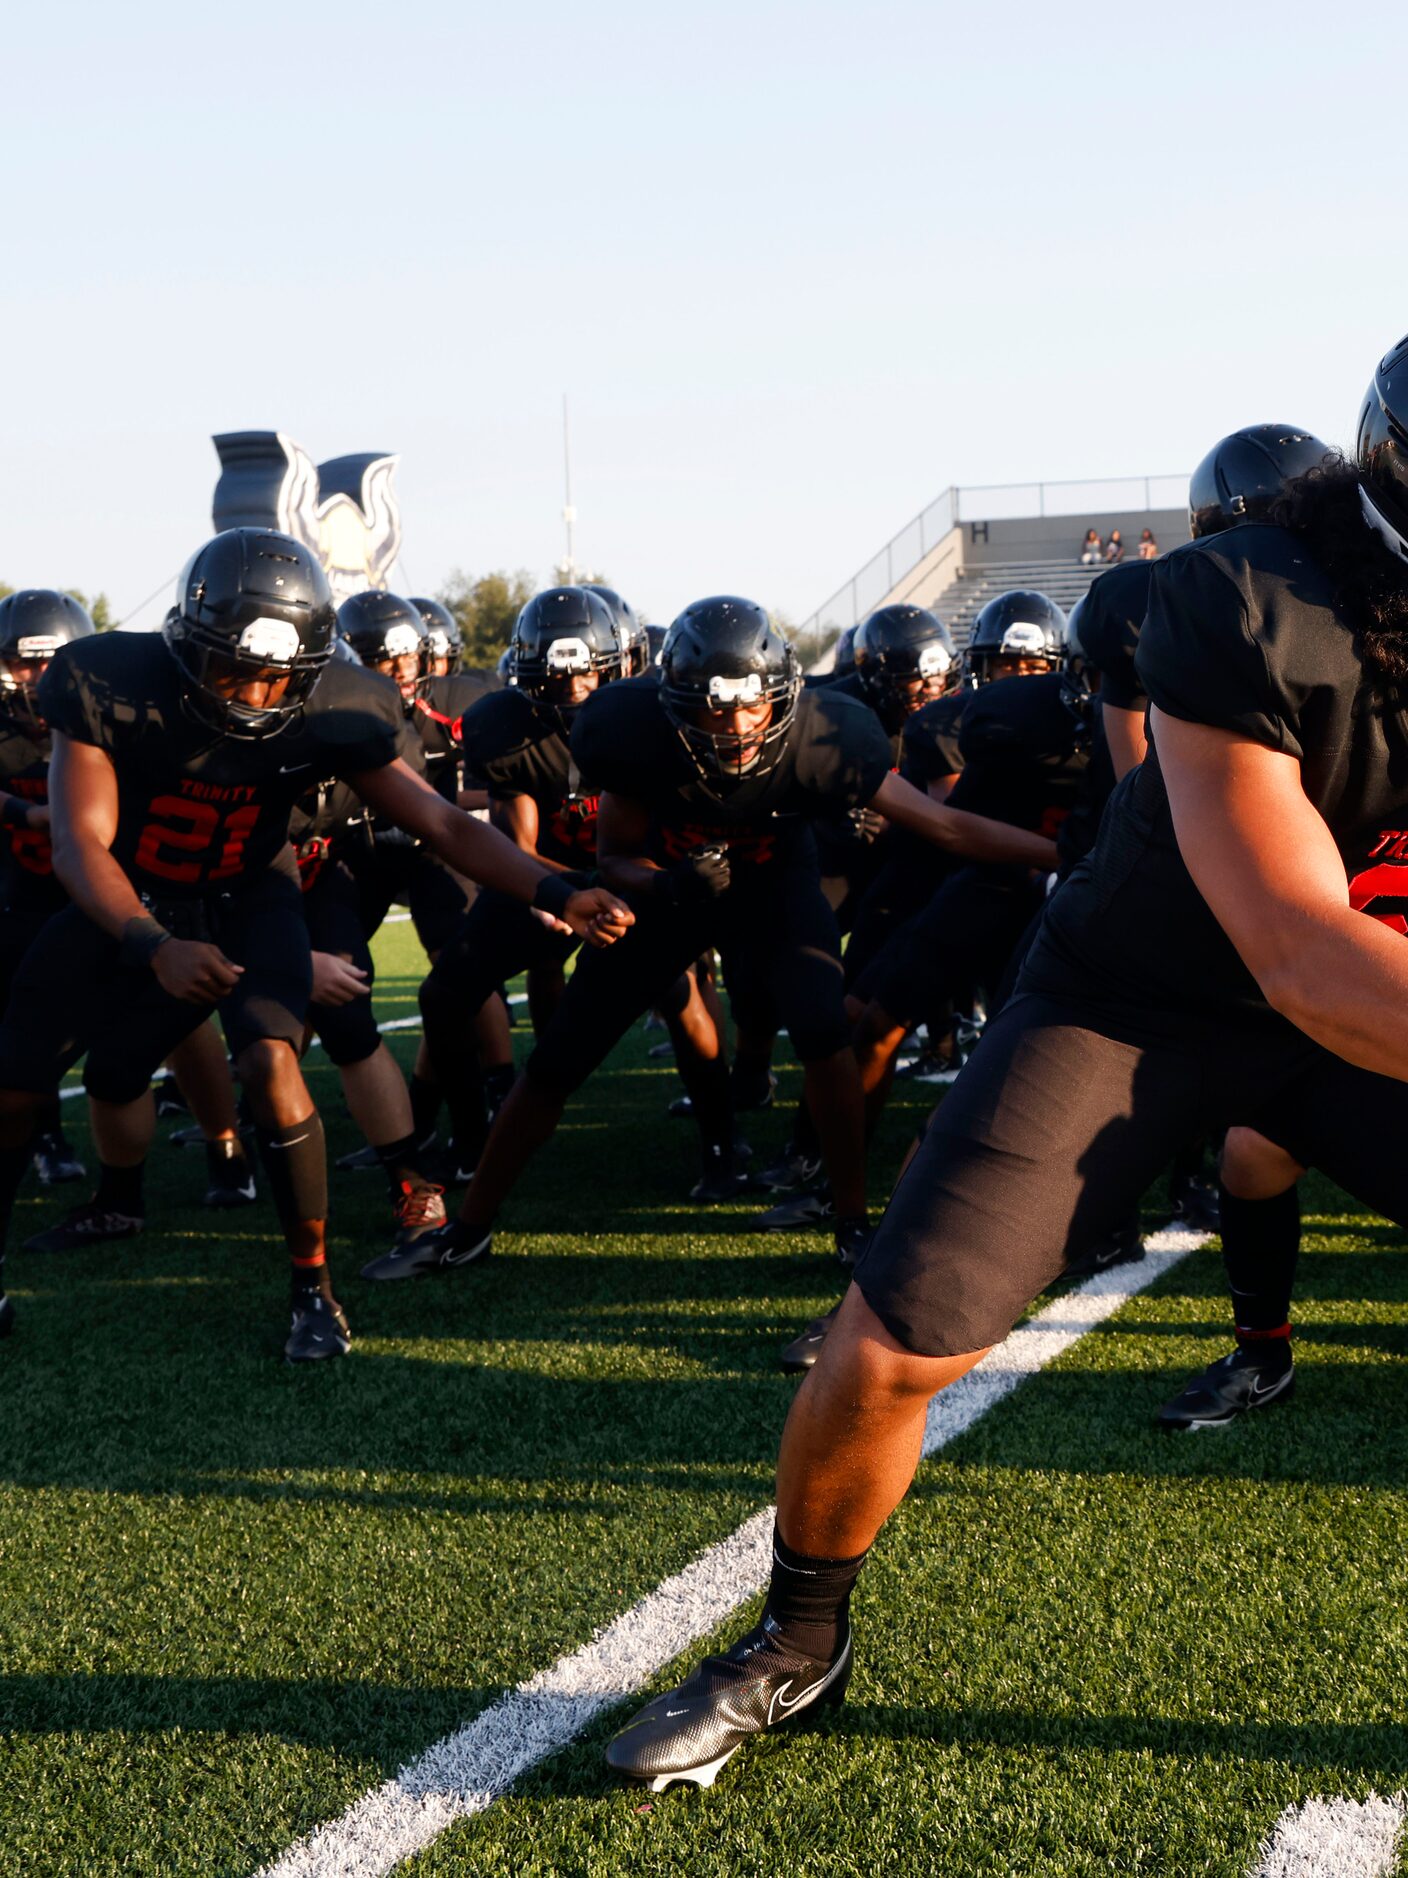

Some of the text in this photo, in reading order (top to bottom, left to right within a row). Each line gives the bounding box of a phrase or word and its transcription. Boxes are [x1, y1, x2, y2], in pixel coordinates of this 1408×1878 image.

[971, 521, 988, 543] H
[180, 779, 256, 801] TRINITY
[136, 796, 262, 883] 21
